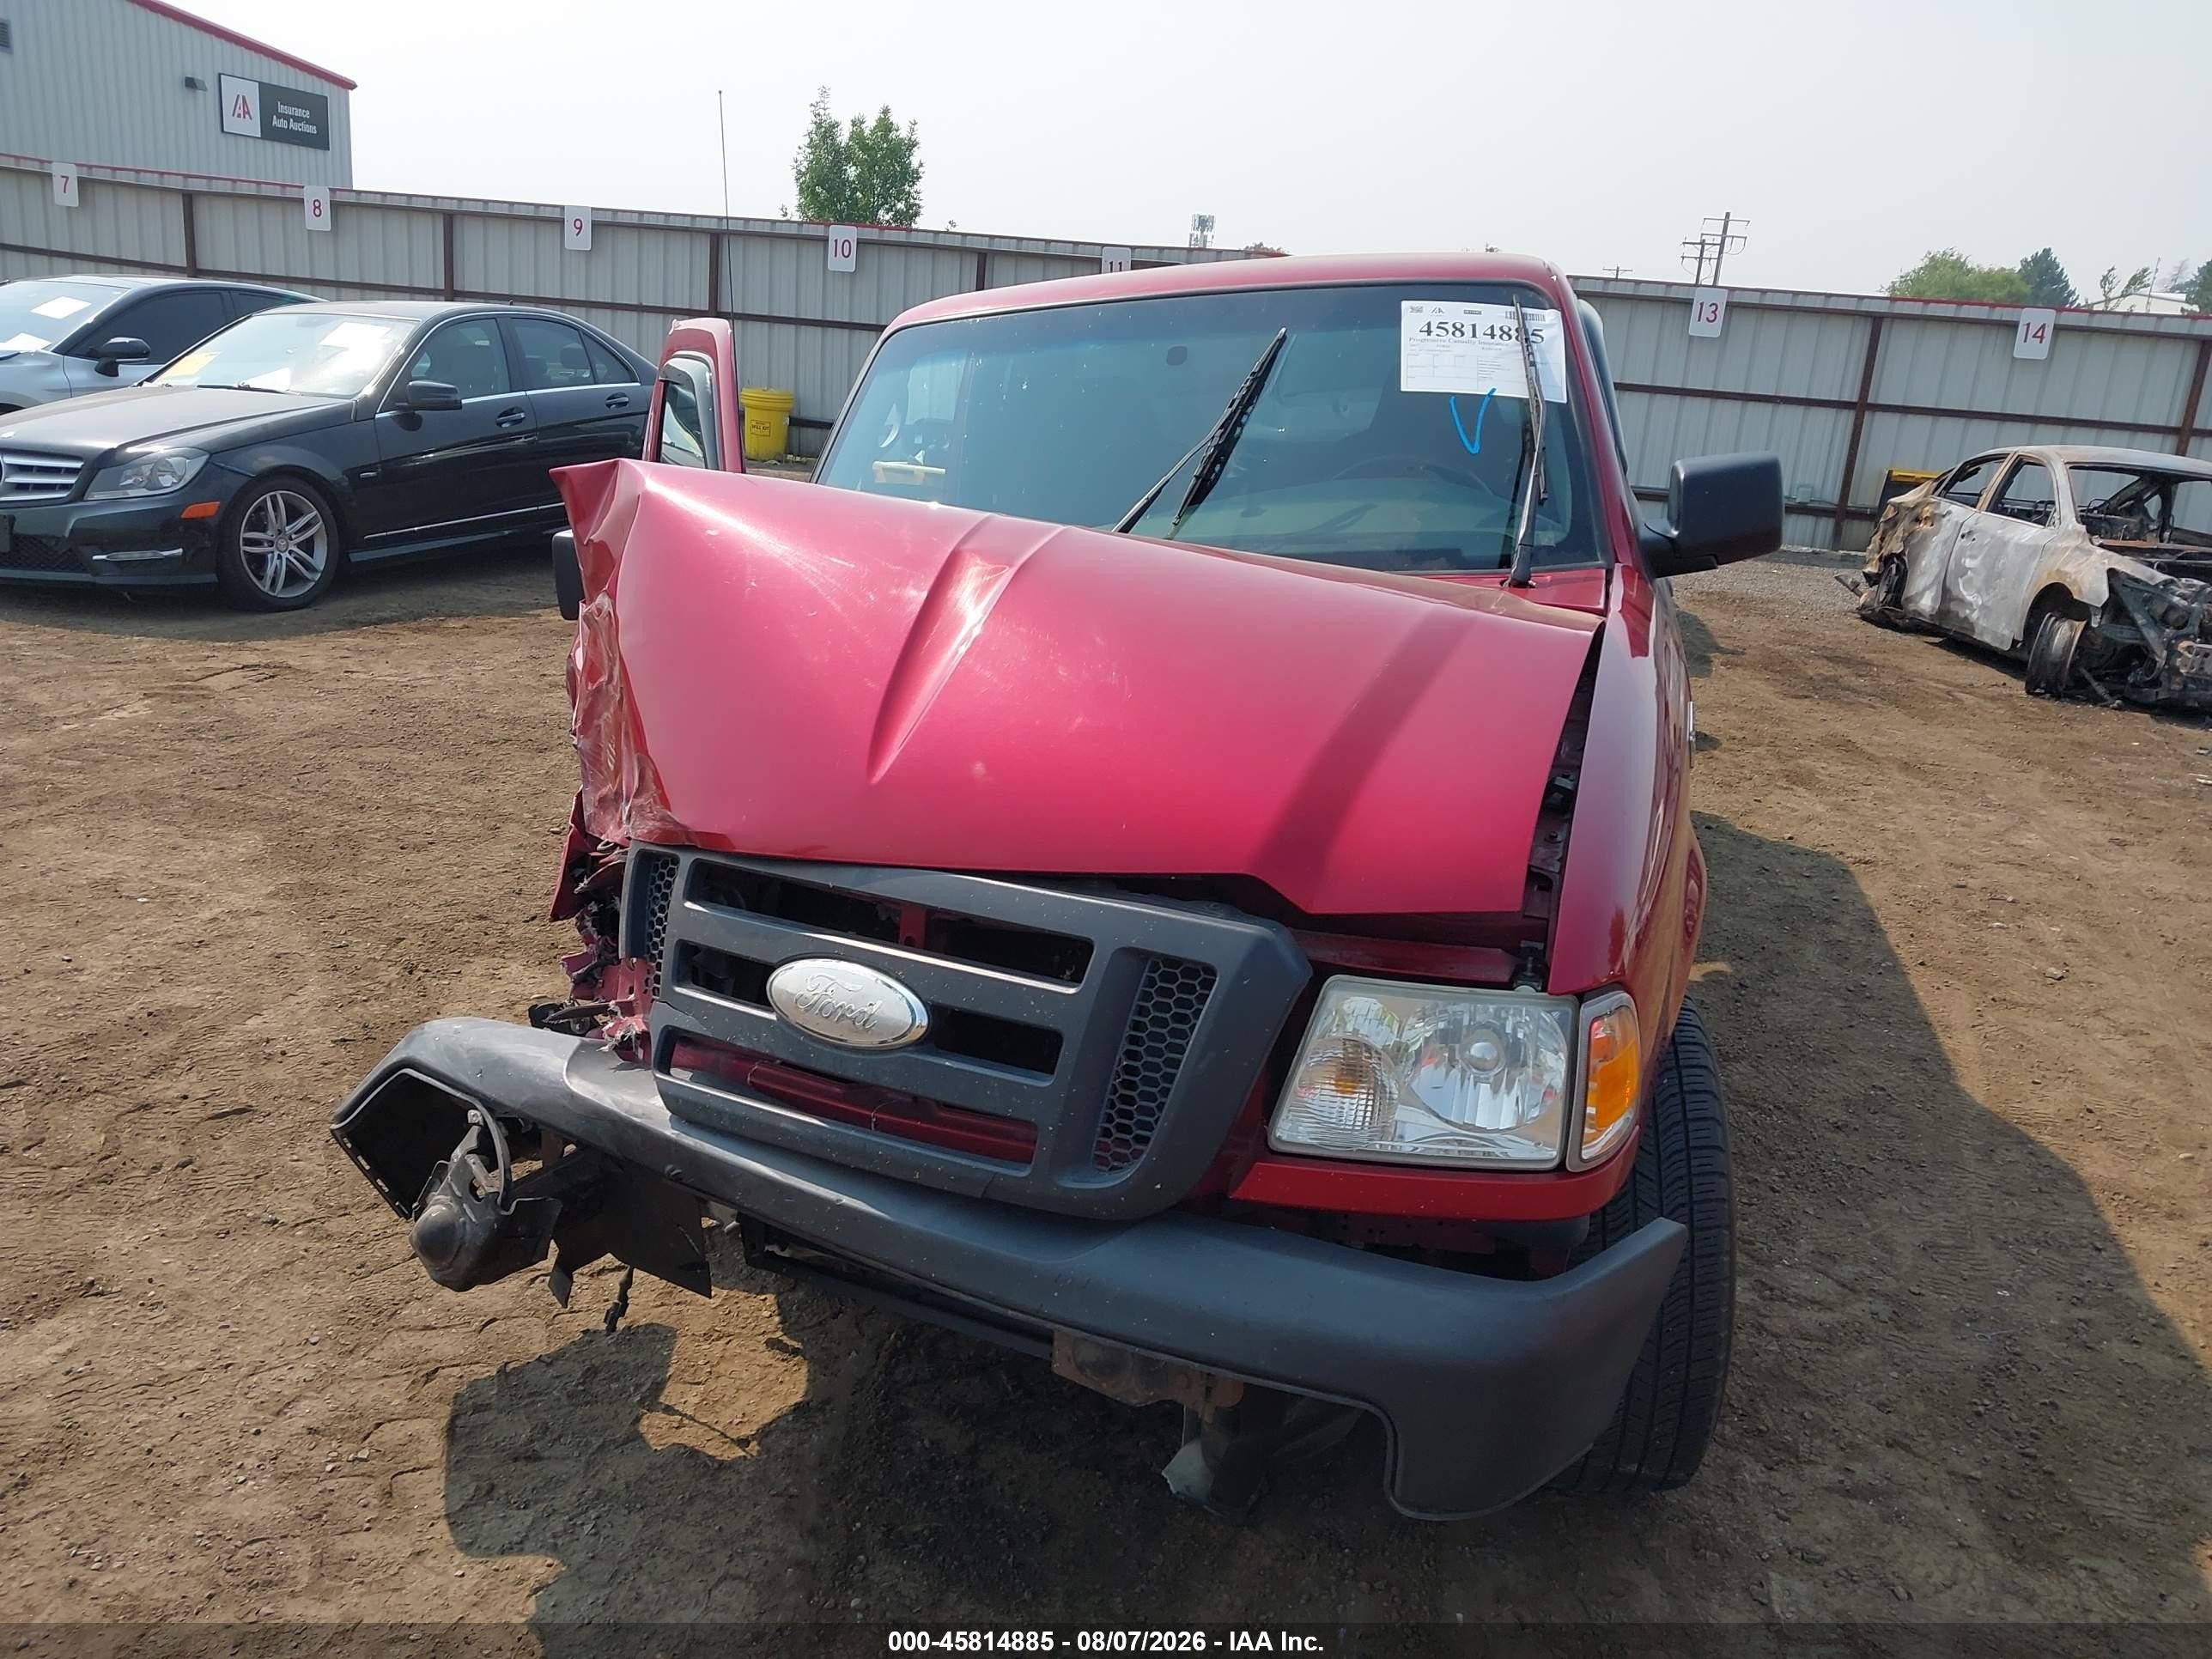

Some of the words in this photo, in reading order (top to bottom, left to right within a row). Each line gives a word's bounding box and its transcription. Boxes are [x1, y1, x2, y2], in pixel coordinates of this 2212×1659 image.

[277, 100, 310, 118] Insurance
[272, 114, 289, 129] Auto
[289, 118, 317, 134] Auctions
[61, 175, 70, 194] 7
[313, 198, 322, 217] 8
[573, 218, 583, 237] 9
[834, 238, 852, 259] 10
[1697, 301, 1719, 324] 13
[2022, 322, 2047, 344] 14
[793, 973, 884, 1030] Ford
